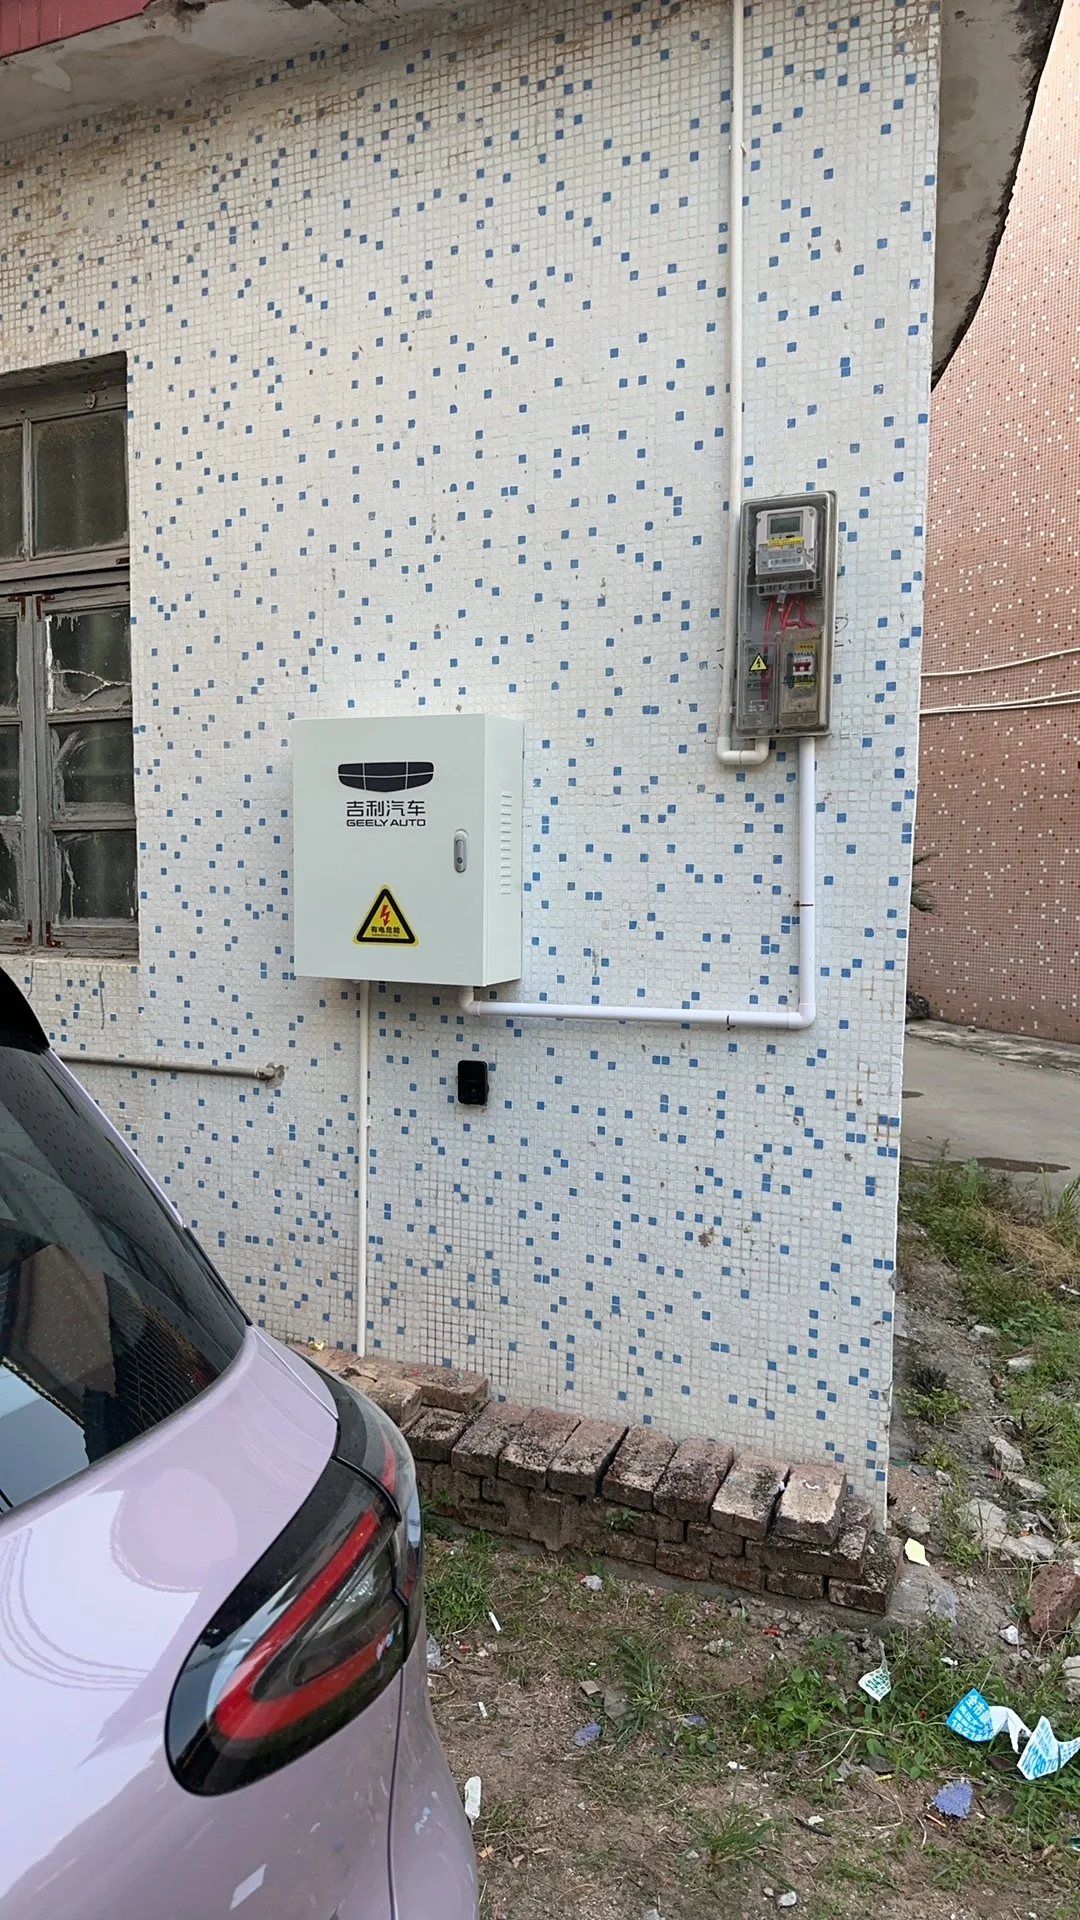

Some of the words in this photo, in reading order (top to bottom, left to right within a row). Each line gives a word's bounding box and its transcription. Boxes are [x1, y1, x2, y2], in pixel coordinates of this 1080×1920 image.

[346, 800, 426, 817] 吉利汽车
[346, 819, 389, 827] GEELY
[389, 819, 426, 827] AUTO
[370, 926, 401, 934] 有电危险
